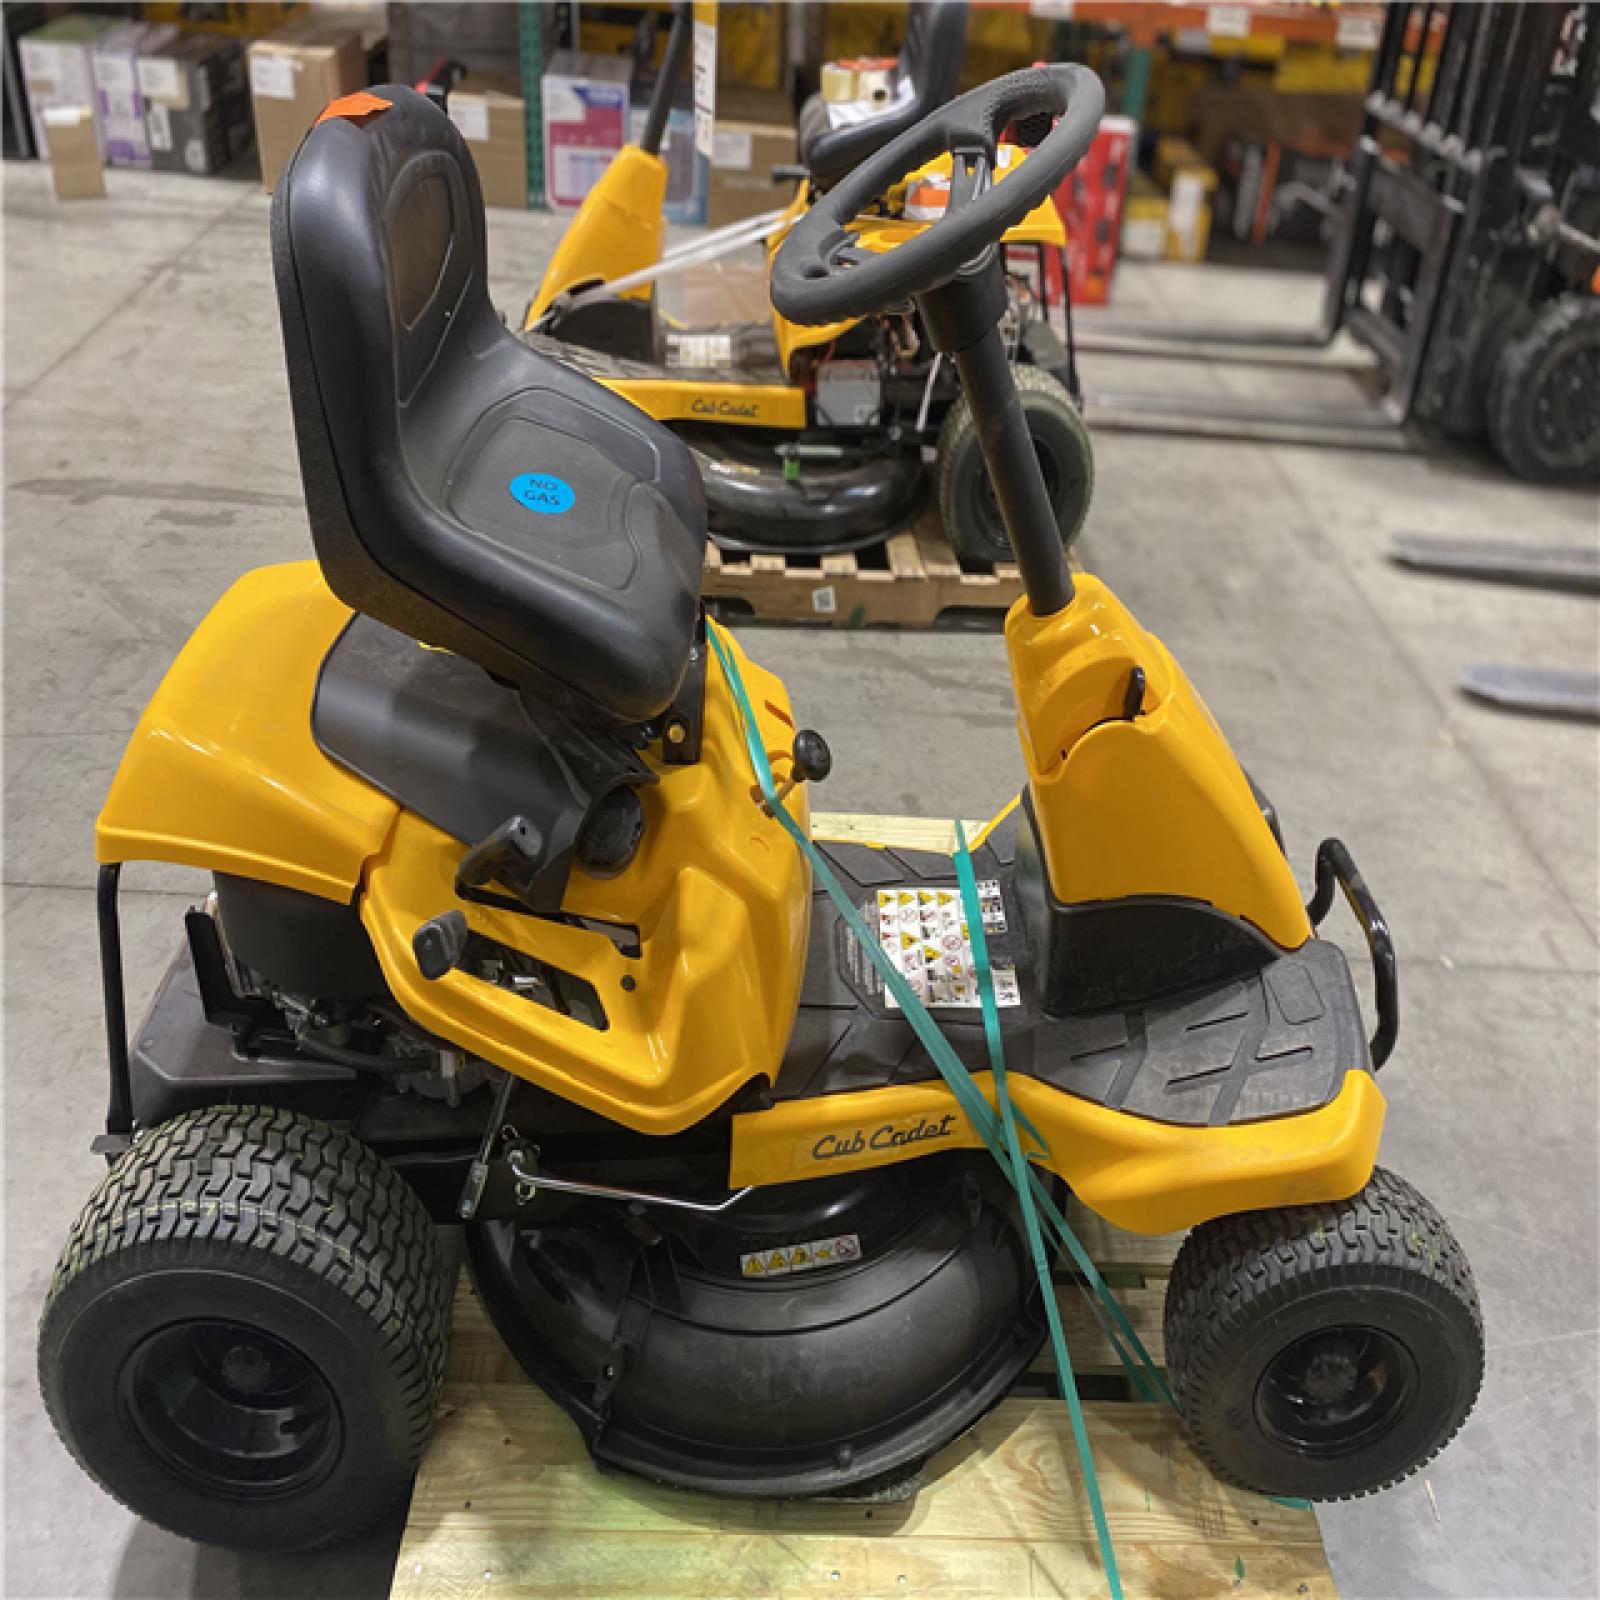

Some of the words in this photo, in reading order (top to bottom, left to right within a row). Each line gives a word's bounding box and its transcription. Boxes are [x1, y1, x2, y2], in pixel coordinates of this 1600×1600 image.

[523, 489, 561, 506] GAS
[812, 1129, 865, 1160] Cub
[869, 1114, 957, 1150] Cadet
